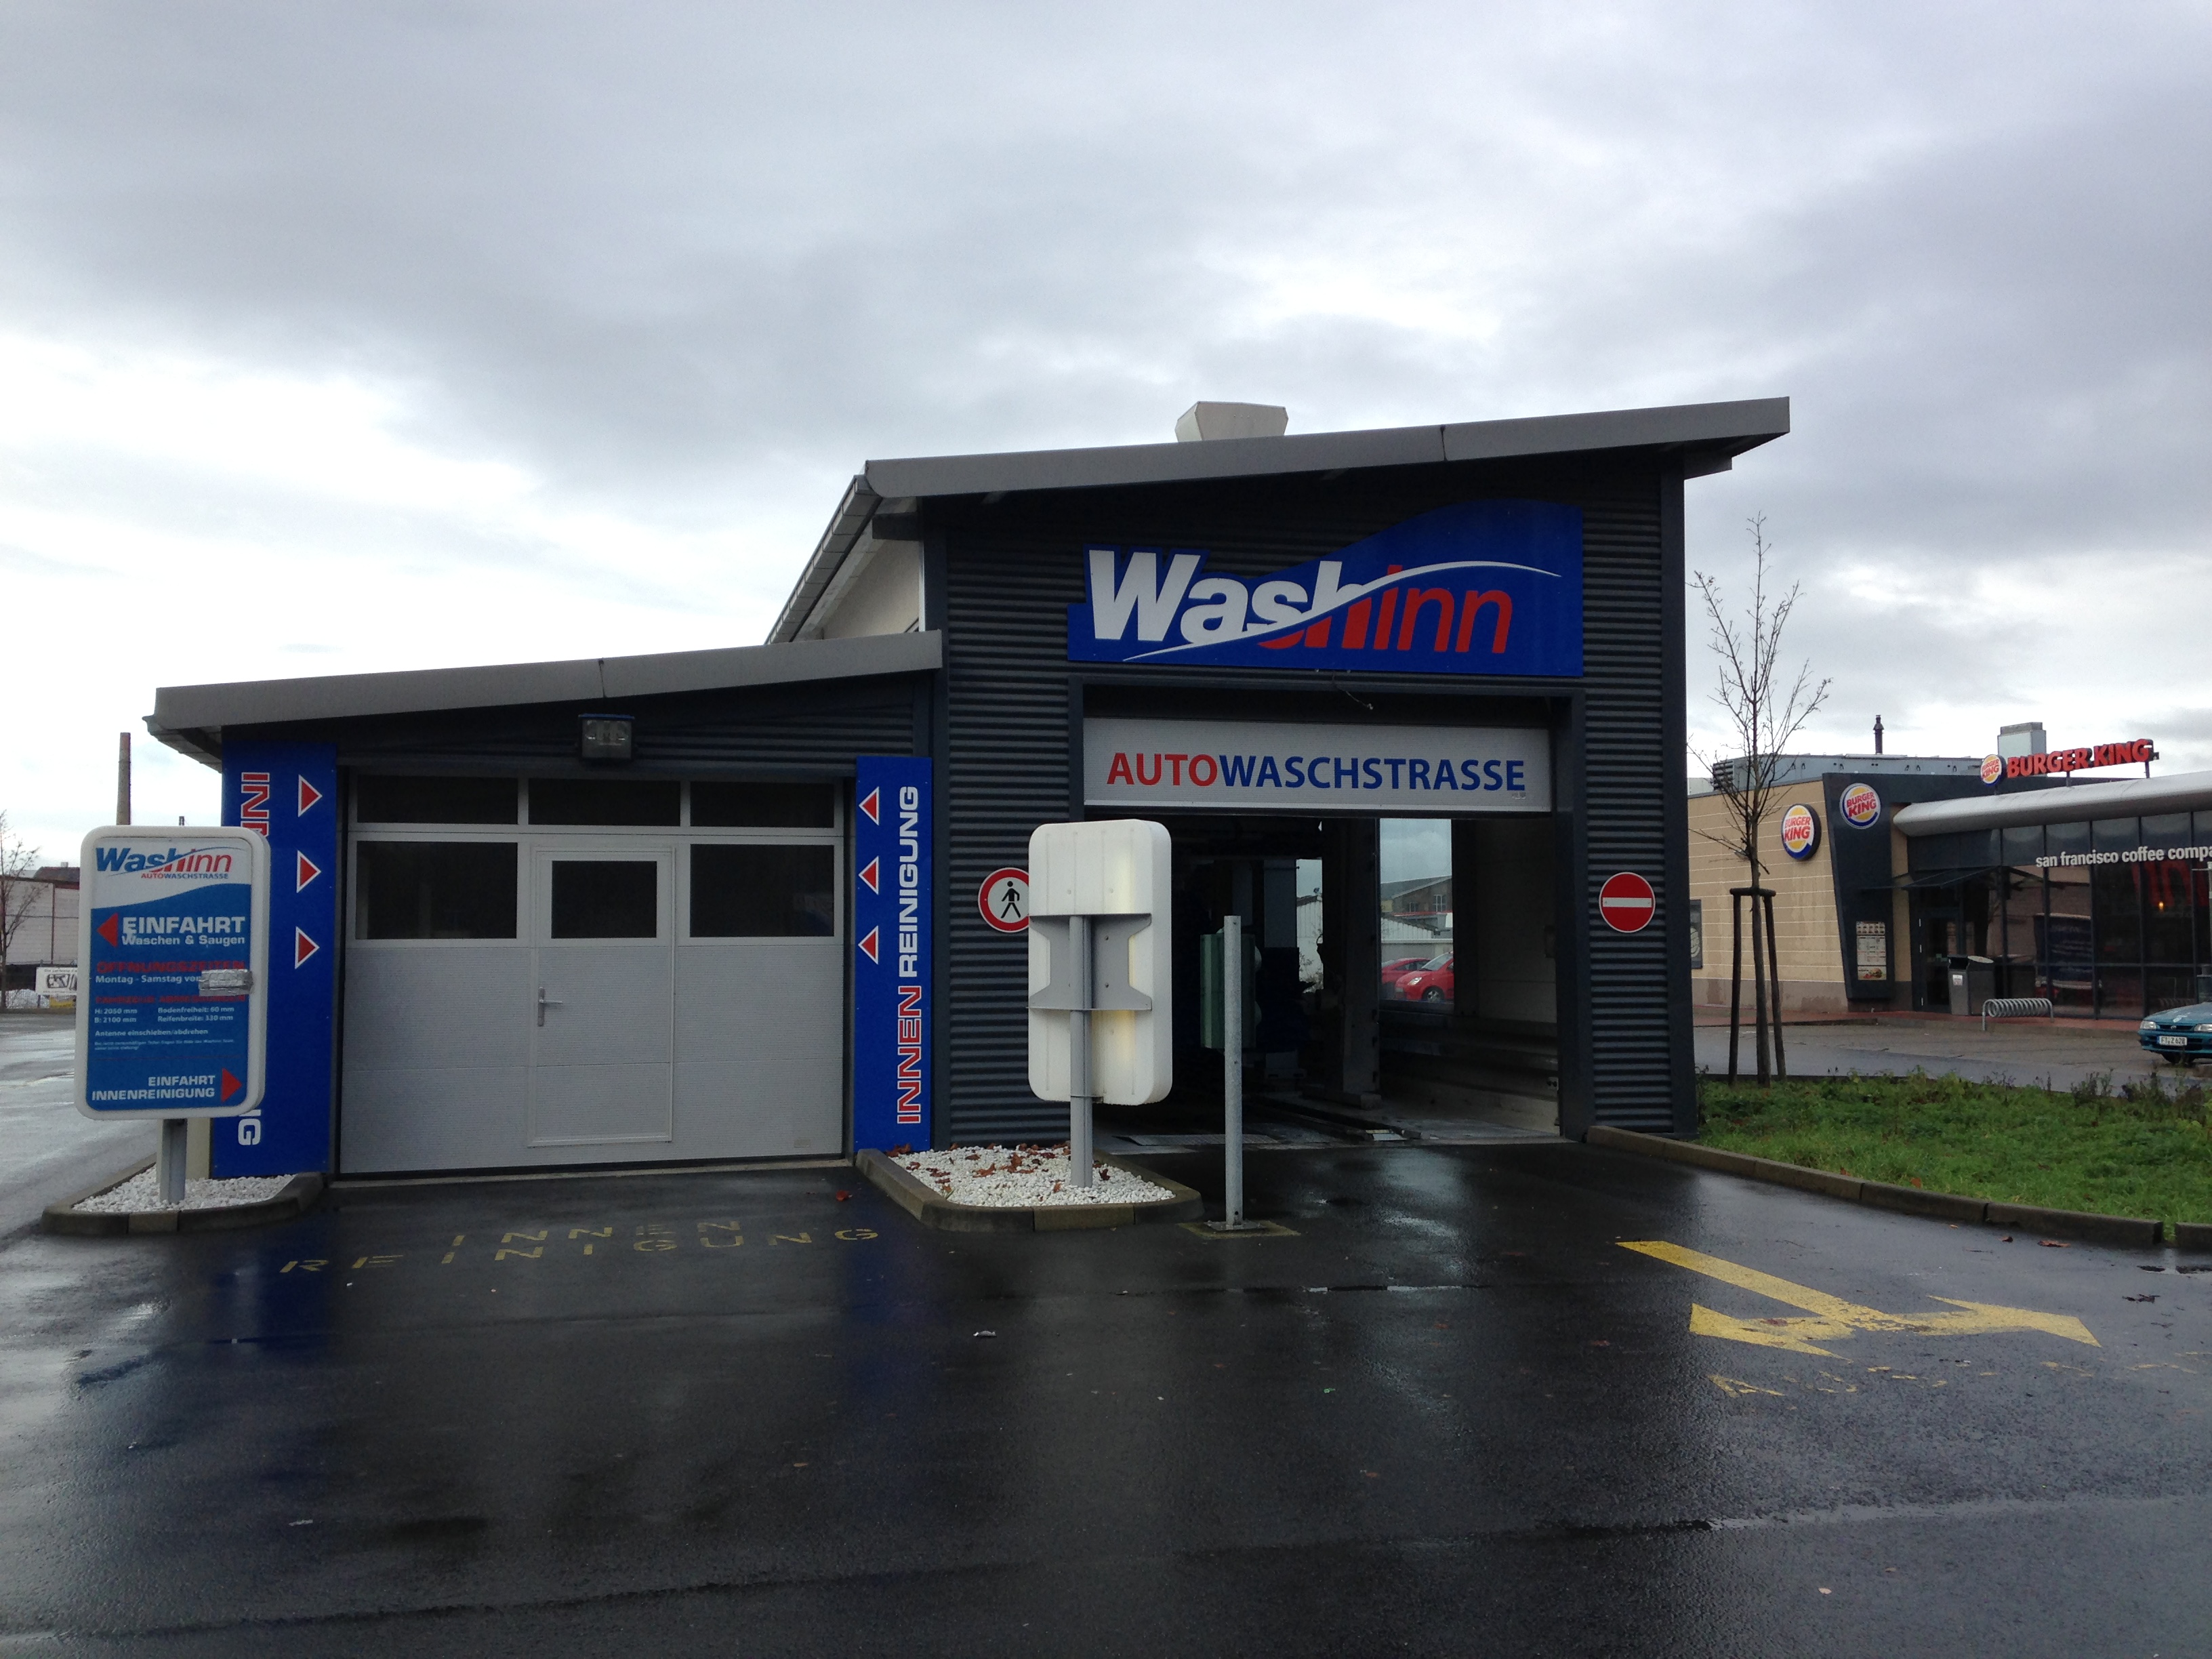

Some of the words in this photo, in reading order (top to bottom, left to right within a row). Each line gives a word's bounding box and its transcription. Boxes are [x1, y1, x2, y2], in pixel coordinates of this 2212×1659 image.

[2007, 748, 2092, 778] BURGER
[2093, 739, 2154, 767] KING
[1107, 753, 1525, 792] AUTOWASCHSTRASSE
[1847, 792, 1875, 807] BURGER
[1848, 800, 1877, 819] KING
[1784, 816, 1811, 829] BURGER
[1784, 826, 1811, 842] KING
[2036, 856, 2057, 868] san
[2061, 849, 2119, 866] francisco
[2122, 846, 2165, 863] coffee
[899, 786, 918, 977] REINIGUNG
[123, 917, 245, 934] EINFAHRT
[121, 934, 180, 945] Waschen
[185, 935, 194, 945] &
[199, 935, 245, 946] Saugen
[96, 975, 134, 985] Montag
[141, 975, 182, 984] Samstag
[897, 986, 921, 1124] INNEN
[148, 1076, 216, 1086] EINFAHRT
[91, 1088, 216, 1101] INNENREINIGUNG
